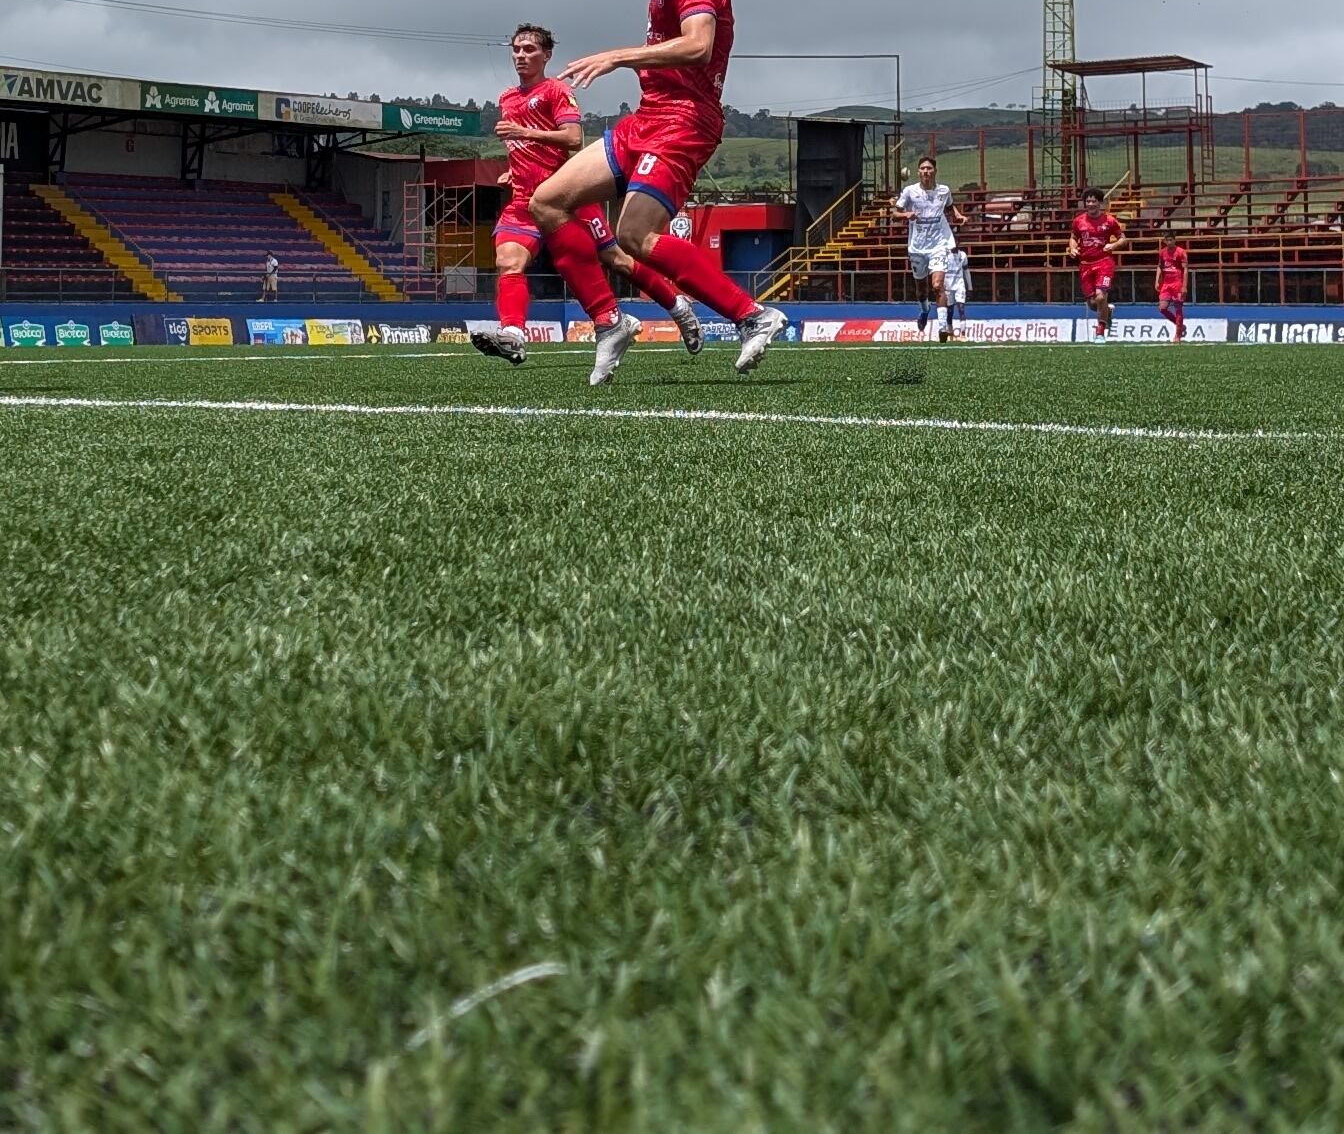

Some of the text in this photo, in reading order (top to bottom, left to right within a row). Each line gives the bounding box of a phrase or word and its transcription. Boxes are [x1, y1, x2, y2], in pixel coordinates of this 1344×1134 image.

[17, 76, 103, 104] AMVAC
[164, 93, 200, 108] Agromix
[221, 98, 255, 113] Agromix
[414, 112, 464, 129] Greenplants
[589, 217, 607, 240] 12
[192, 325, 229, 336] SPORTS
[381, 325, 431, 344] PIONEER
[1026, 322, 1058, 339] Piña
